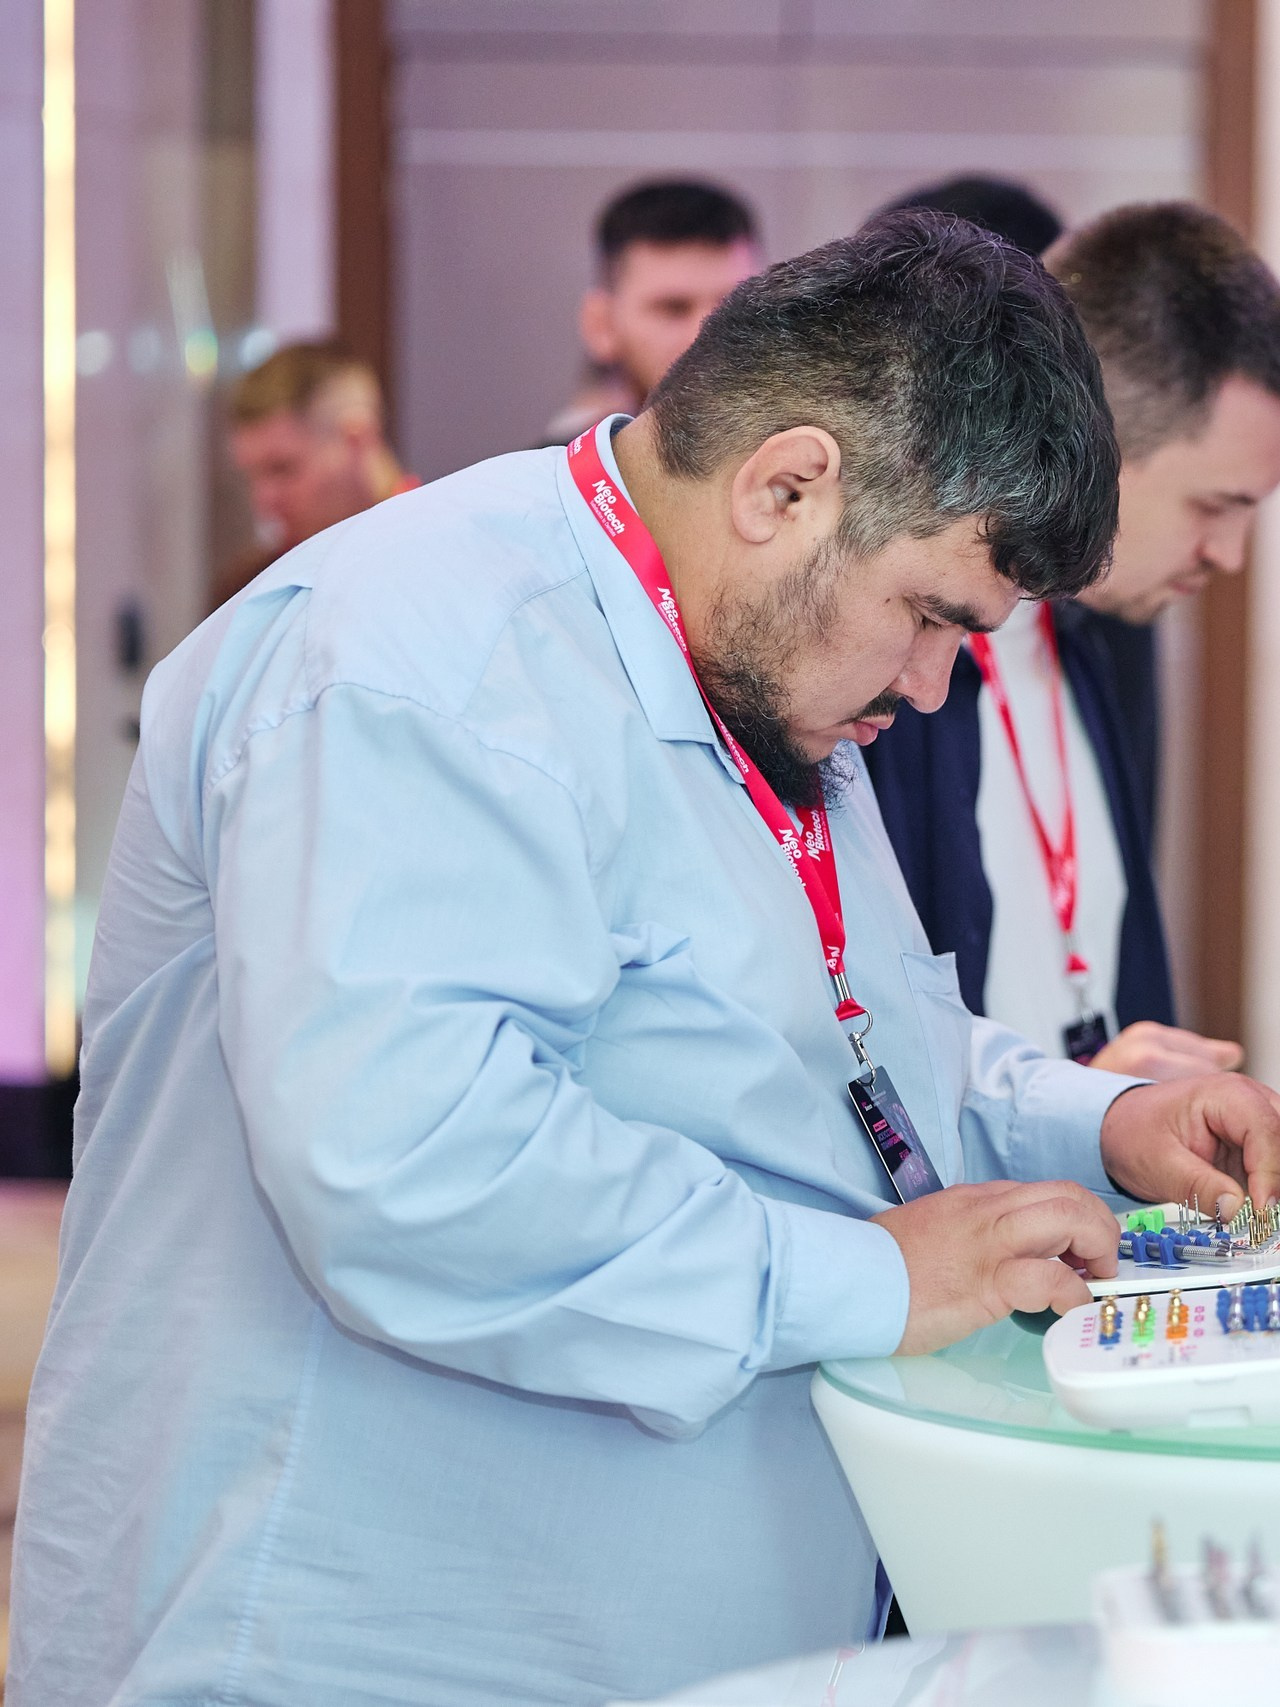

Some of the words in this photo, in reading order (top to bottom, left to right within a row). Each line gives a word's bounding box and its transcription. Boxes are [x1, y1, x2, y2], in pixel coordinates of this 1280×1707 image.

[592, 479, 617, 504] Neo
[593, 492, 625, 534] Biotech
[657, 586, 679, 618] Neo
[778, 829, 802, 859] Neo
[804, 831, 821, 862] Neo
